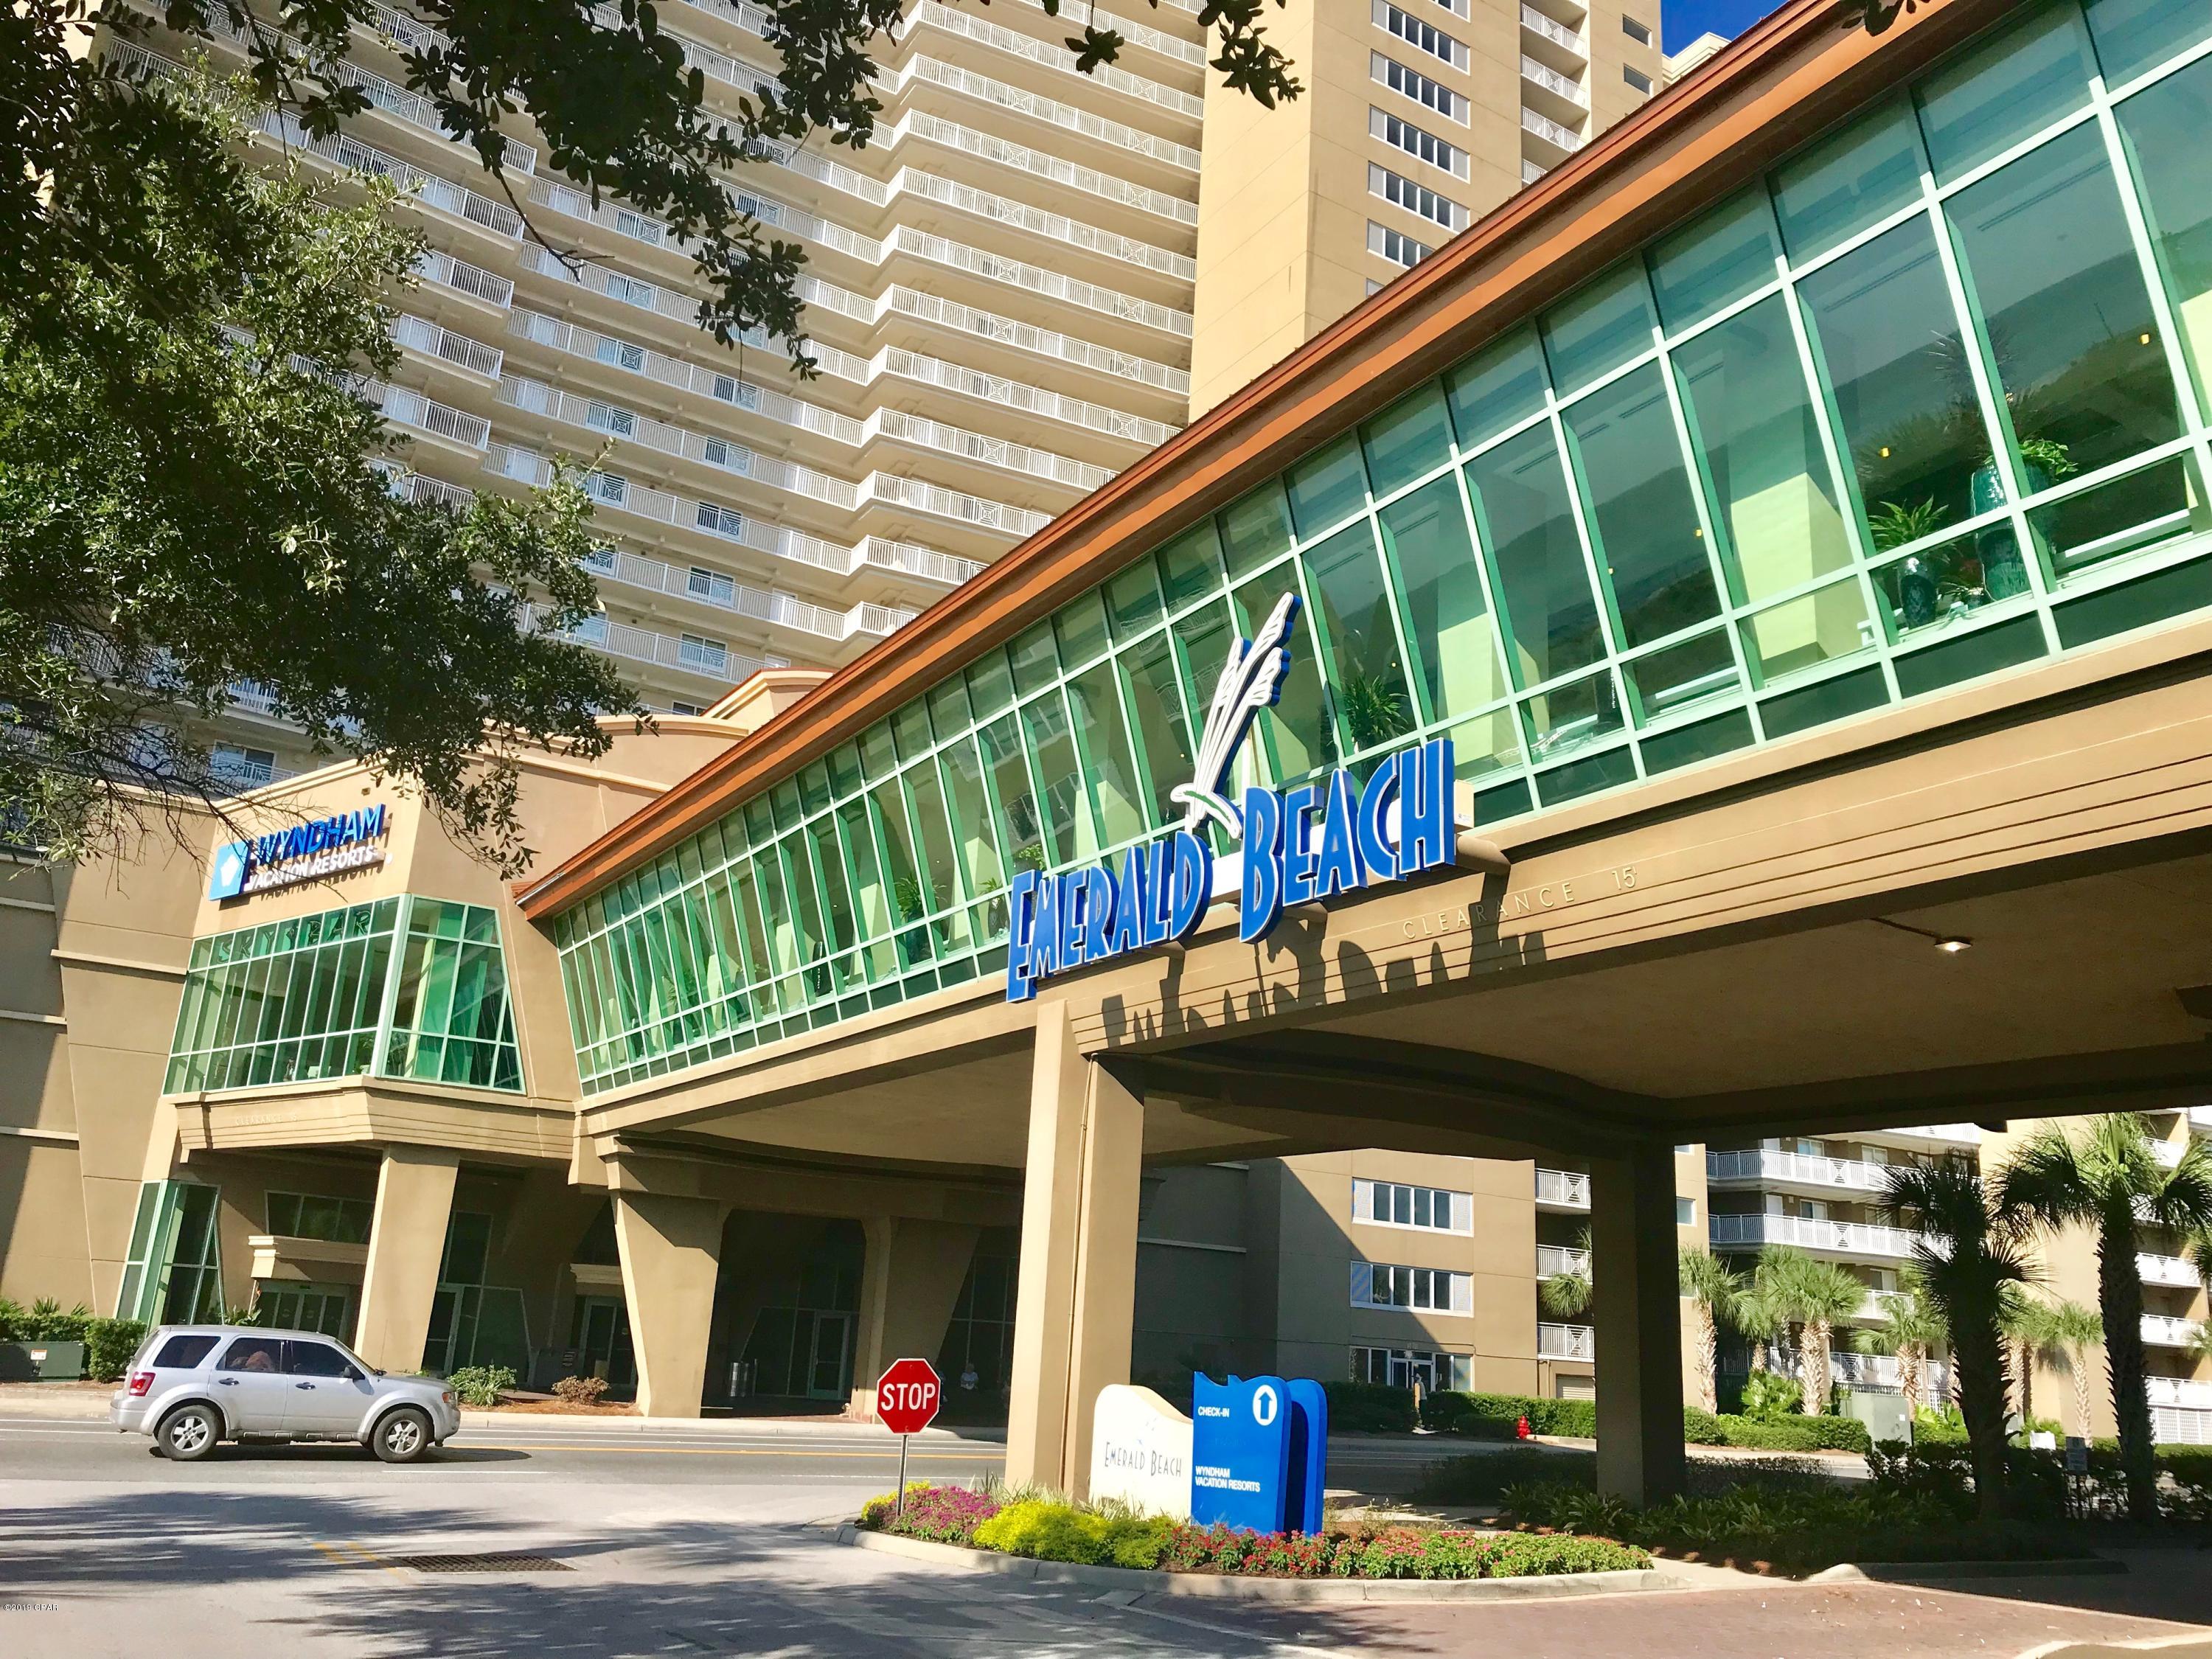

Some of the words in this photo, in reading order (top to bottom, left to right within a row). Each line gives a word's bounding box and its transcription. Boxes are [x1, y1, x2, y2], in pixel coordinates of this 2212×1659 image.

[258, 803, 386, 866] WYNDHAM
[248, 860, 308, 889] VACATION
[310, 845, 375, 875] RESORTS
[1006, 830, 1214, 1004] EMERALD
[1239, 737, 1456, 944] BEACH
[1402, 882, 1575, 939] CLEARANCE
[880, 1382, 936, 1411] STOP
[1197, 1405, 1230, 1418] CHECK-IN
[1105, 1441, 1145, 1470] EMERALD
[1150, 1450, 1182, 1477] BEACH
[1195, 1465, 1231, 1478] WYNDHAM
[1194, 1476, 1228, 1489] VACATION
[1228, 1480, 1261, 1493] RESORTS
